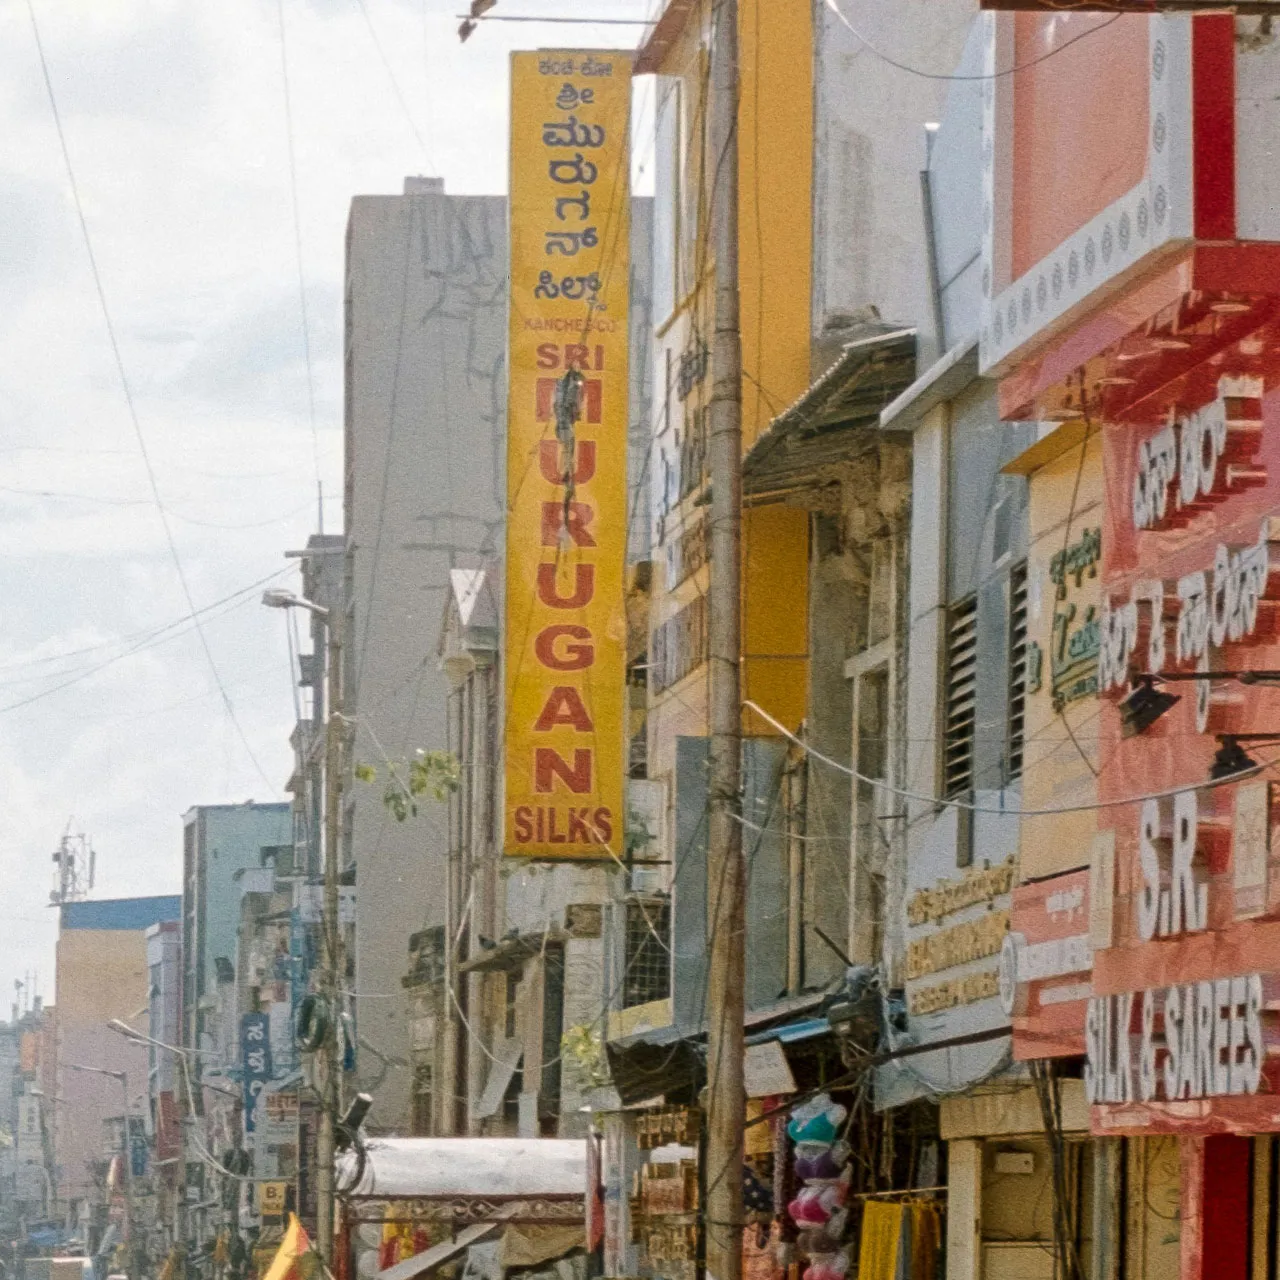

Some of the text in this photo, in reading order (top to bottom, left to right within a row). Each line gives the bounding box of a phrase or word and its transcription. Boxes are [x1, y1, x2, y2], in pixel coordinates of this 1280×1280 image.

[556, 82, 595, 110] ಶ್ರೀ
[535, 342, 605, 371] SRI
[514, 805, 613, 845] SILKS
[1083, 993, 1133, 1105] SILK
[1140, 986, 1157, 1102] &
[1164, 972, 1264, 1101] SAREES
